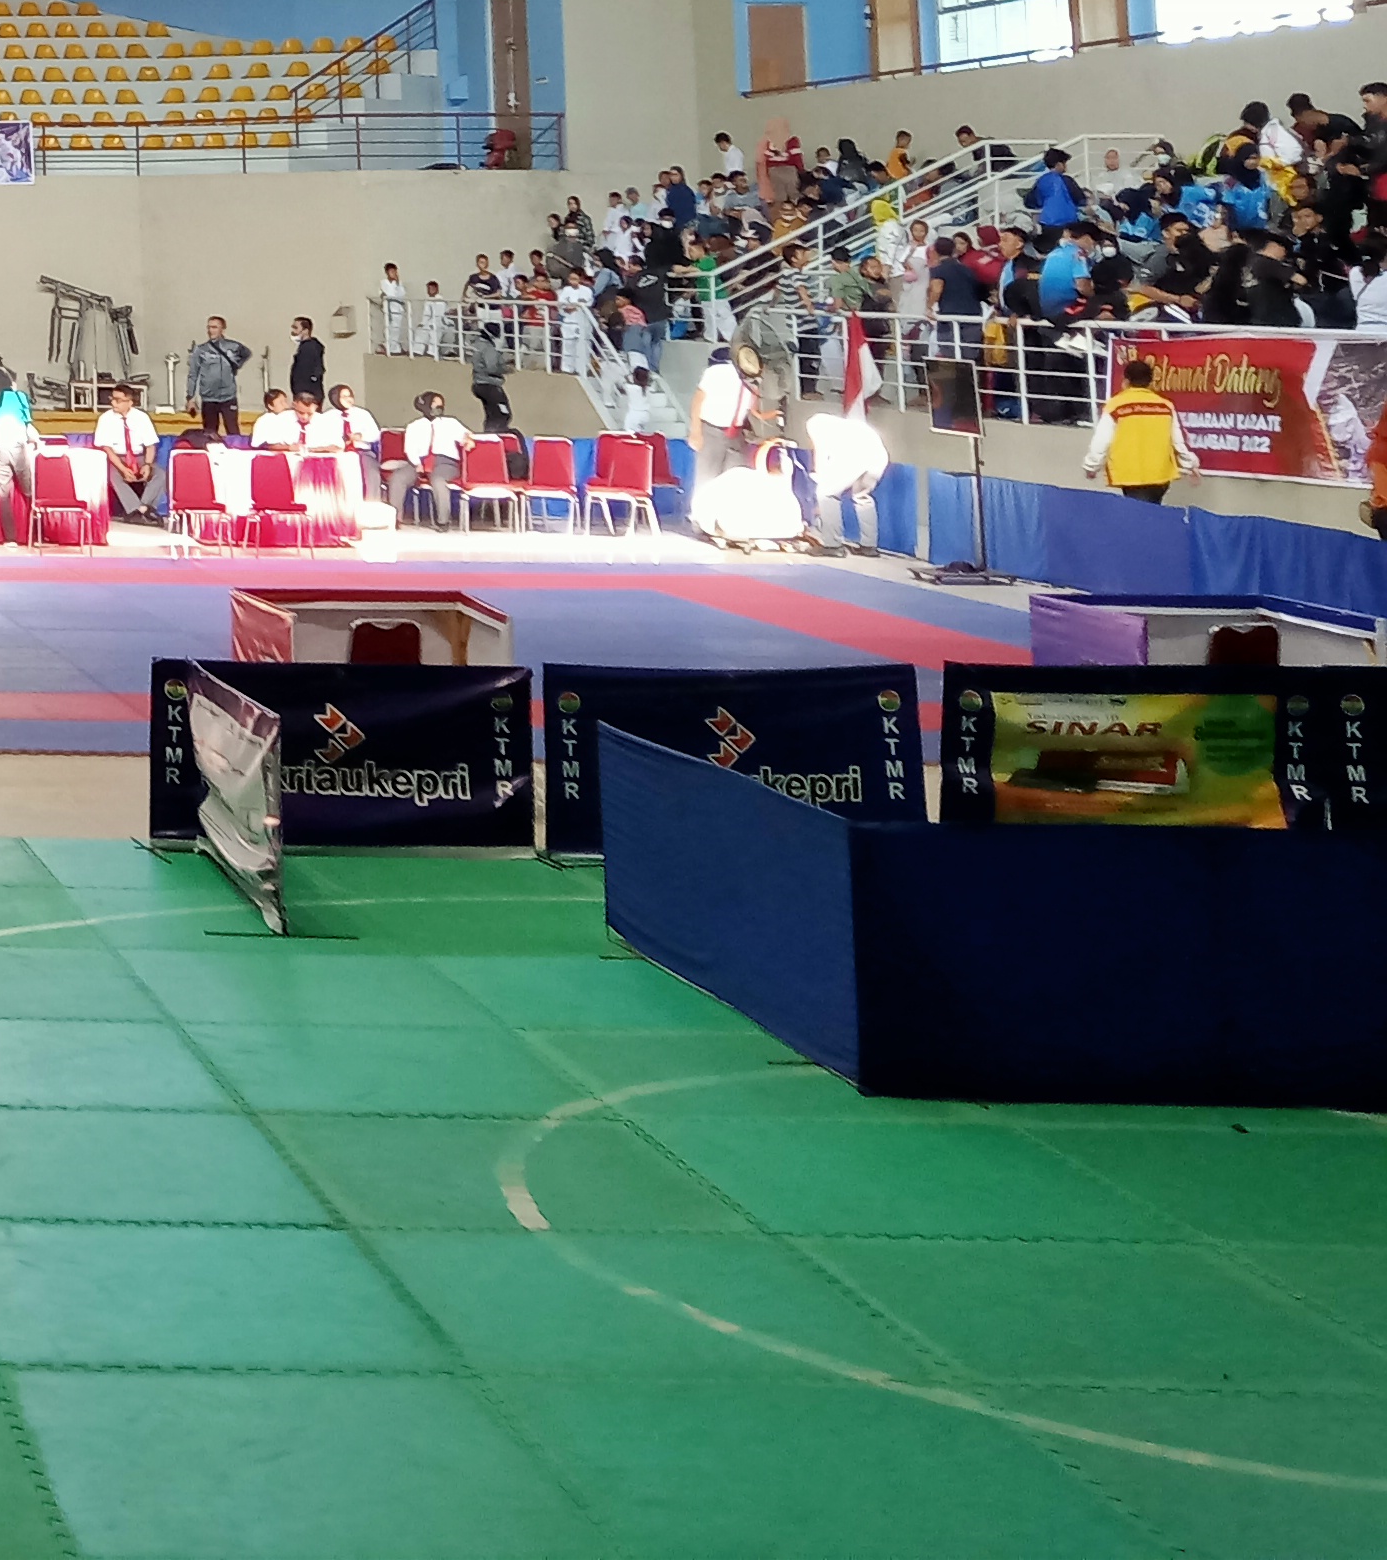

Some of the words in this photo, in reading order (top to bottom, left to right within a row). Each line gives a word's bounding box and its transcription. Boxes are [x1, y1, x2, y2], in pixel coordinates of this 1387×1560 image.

[1213, 353, 1282, 408] Datang
[165, 704, 184, 785] KTMR
[492, 717, 513, 799] KTMR
[560, 718, 580, 800] KTMR
[881, 716, 906, 800] KTMR
[956, 715, 979, 795] KTMR
[1026, 720, 1163, 737] SINAR
[1287, 721, 1313, 801] KTMR
[1345, 721, 1370, 804] KTMR
